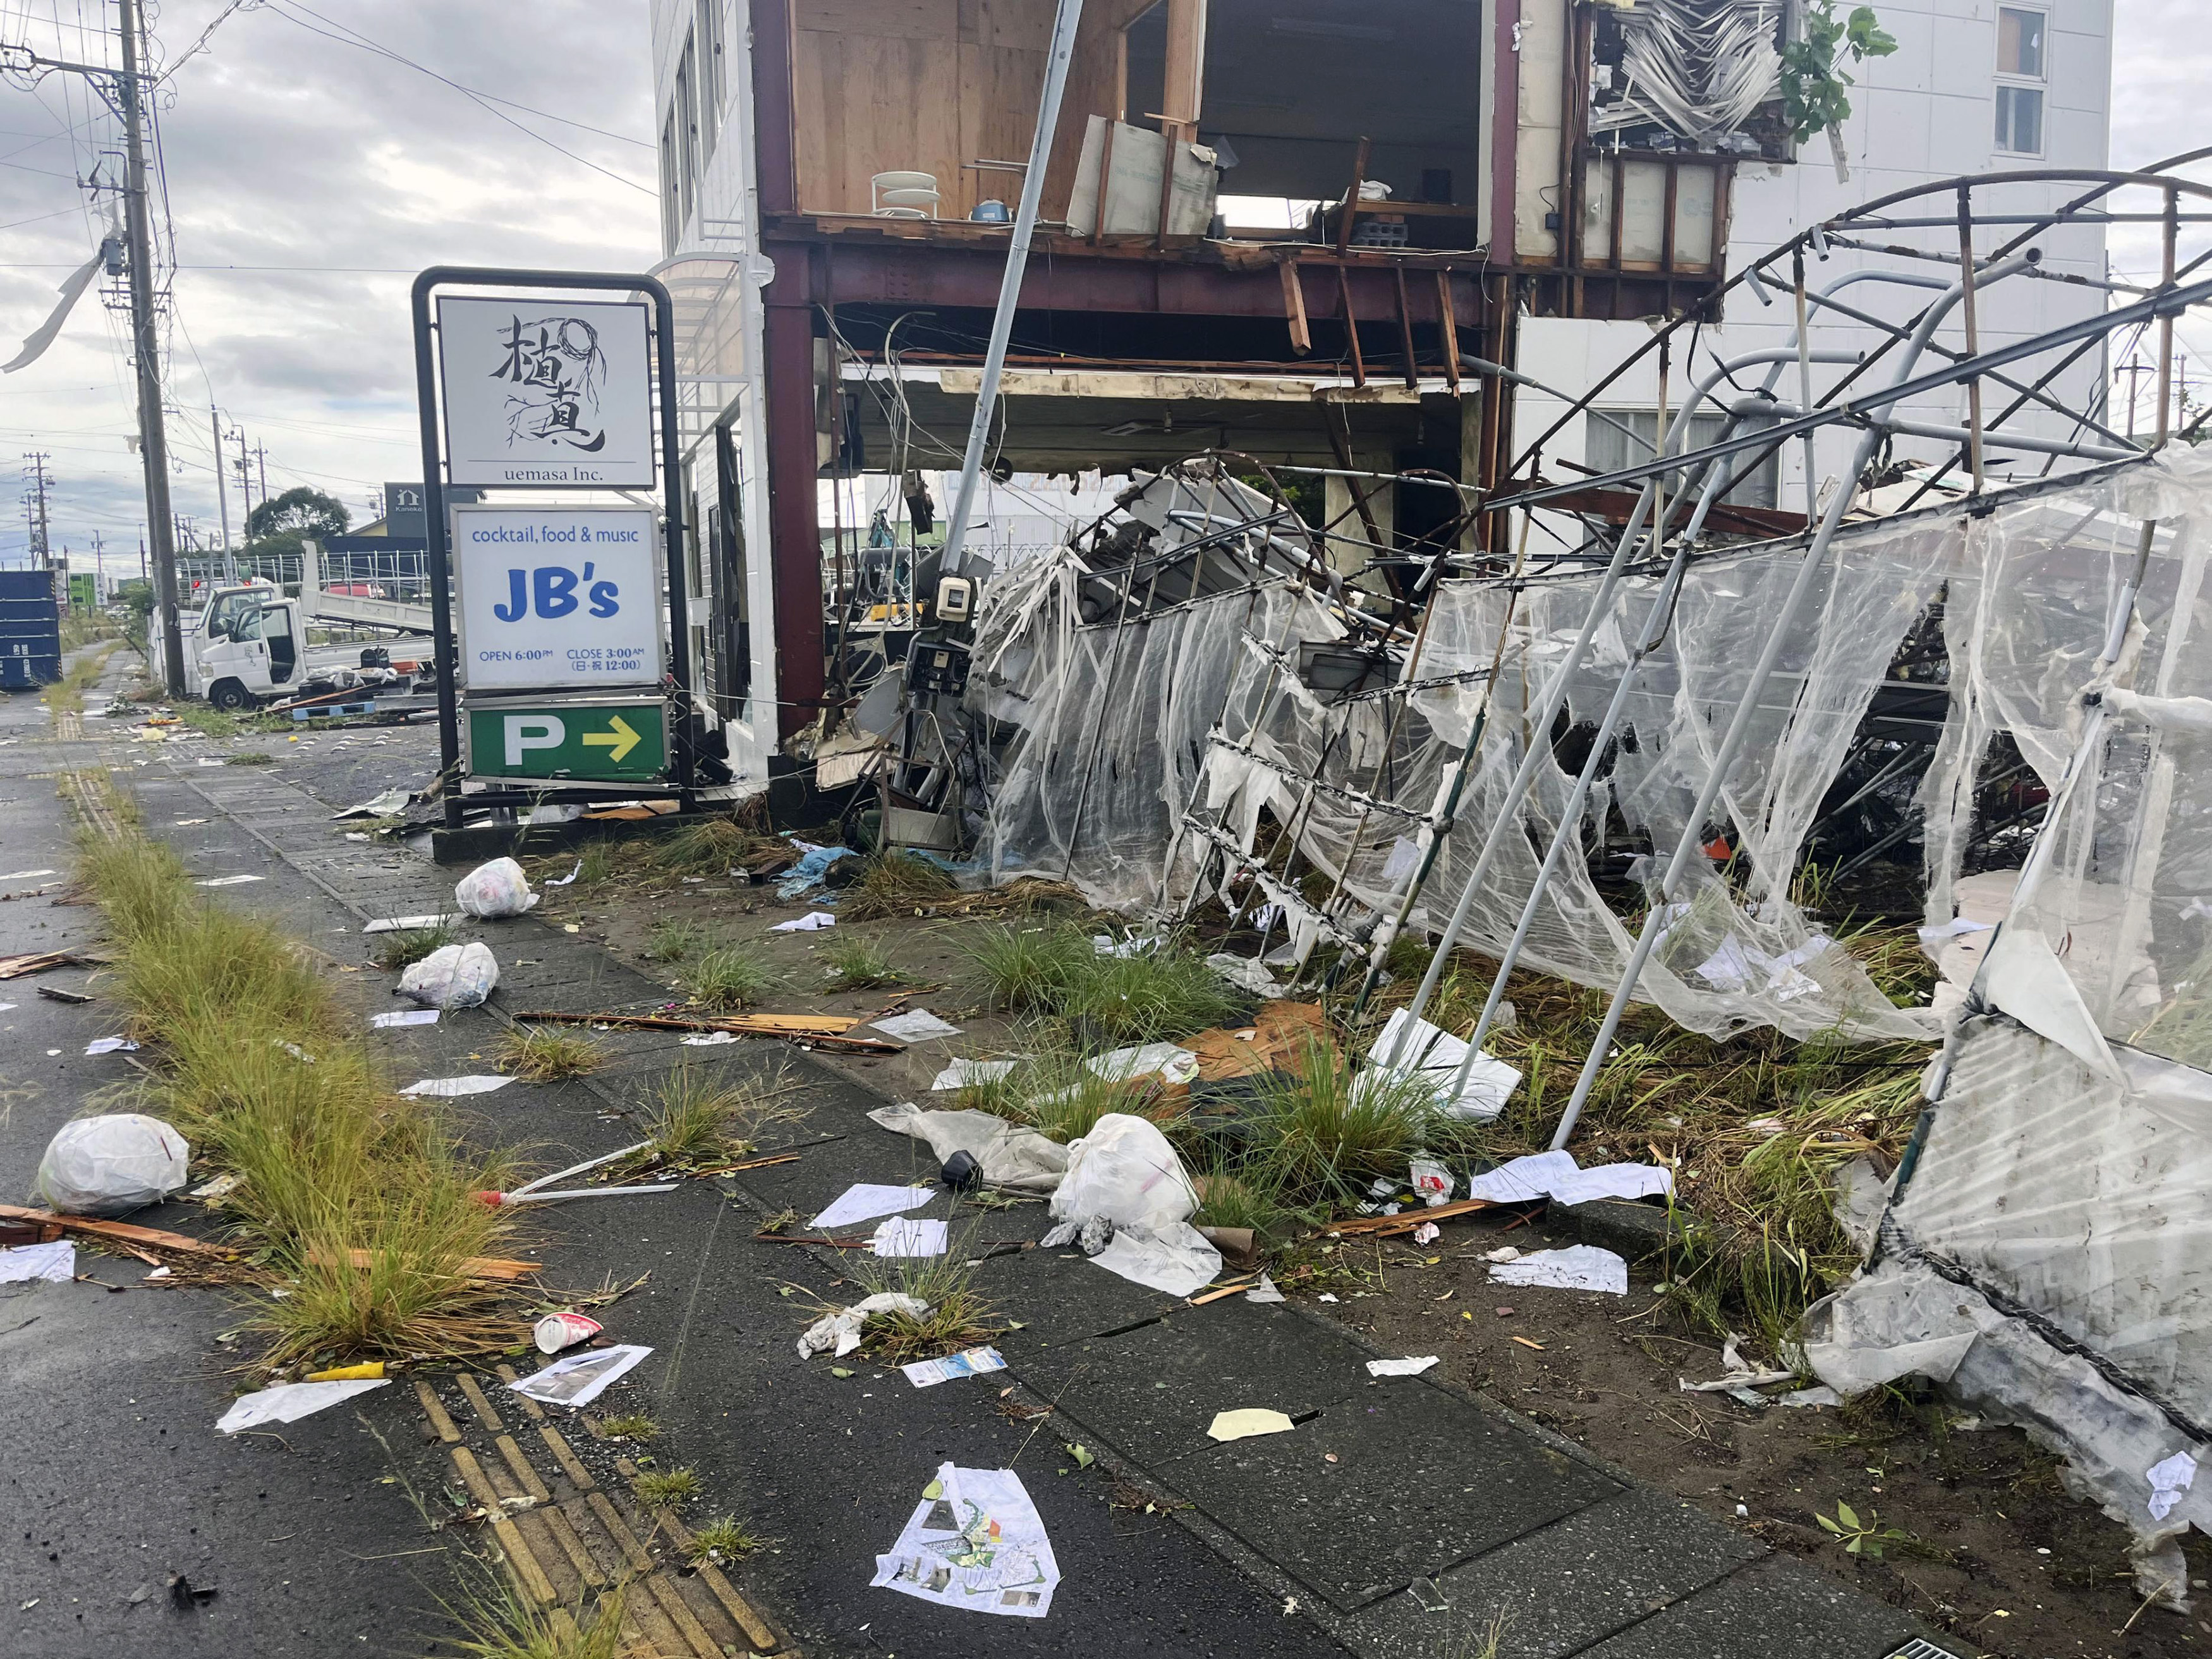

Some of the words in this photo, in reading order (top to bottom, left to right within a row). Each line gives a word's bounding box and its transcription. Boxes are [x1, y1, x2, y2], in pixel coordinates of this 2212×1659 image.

[504, 470, 568, 481] uemasa
[573, 466, 603, 481] Inc.
[472, 525, 538, 544] cocktail,
[541, 525, 576, 543] food
[580, 526, 592, 542] &
[596, 530, 639, 542] music
[494, 562, 620, 623] JB's
[479, 650, 512, 662] OPEN
[566, 648, 603, 660] CLOSE
[503, 715, 566, 766] P
